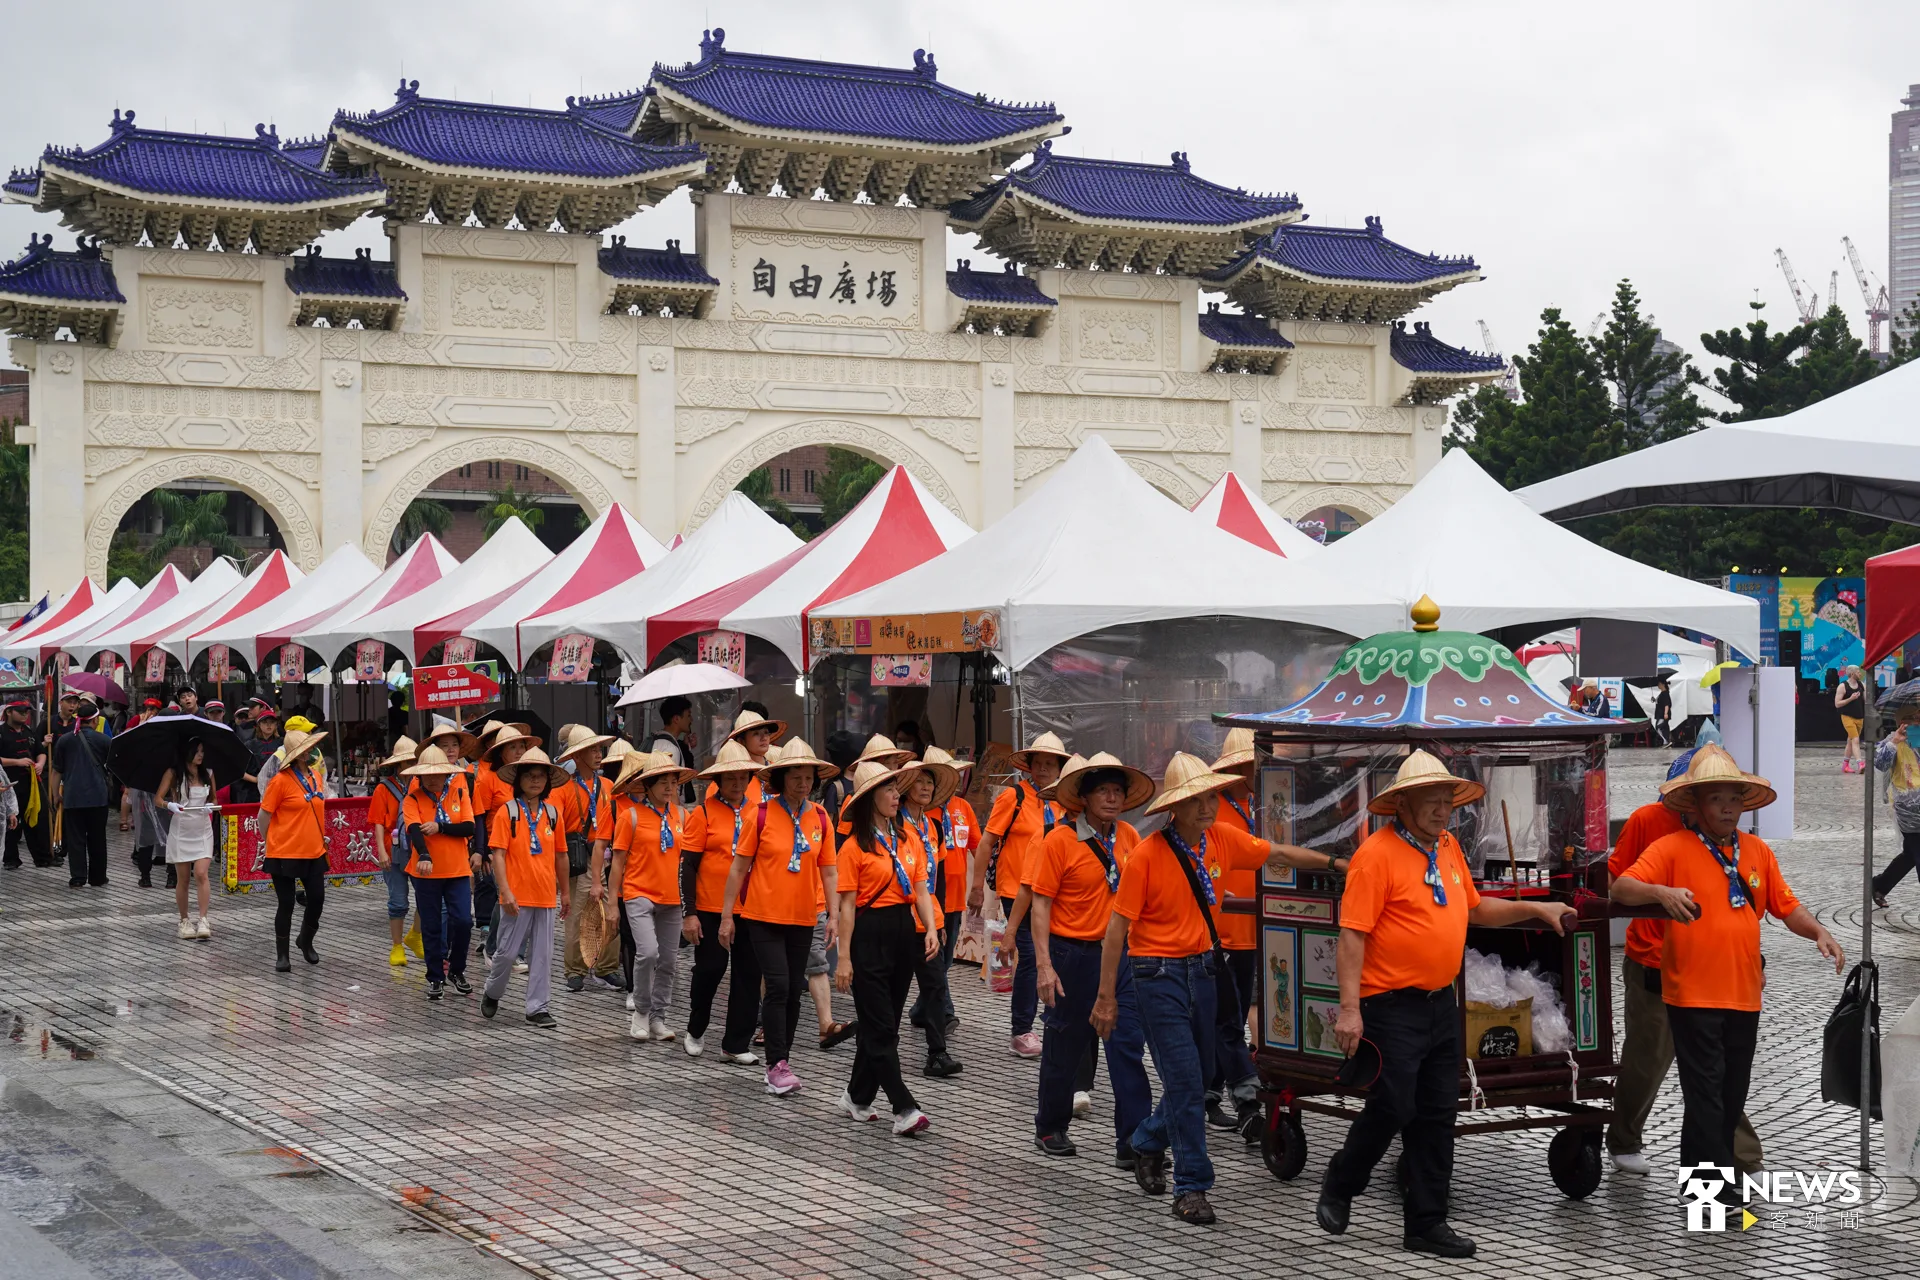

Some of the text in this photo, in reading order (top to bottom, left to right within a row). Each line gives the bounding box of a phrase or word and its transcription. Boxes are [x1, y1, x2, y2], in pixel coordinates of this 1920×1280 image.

[752, 257, 898, 308] 自由廣場
[1778, 594, 1815, 617] 客家
